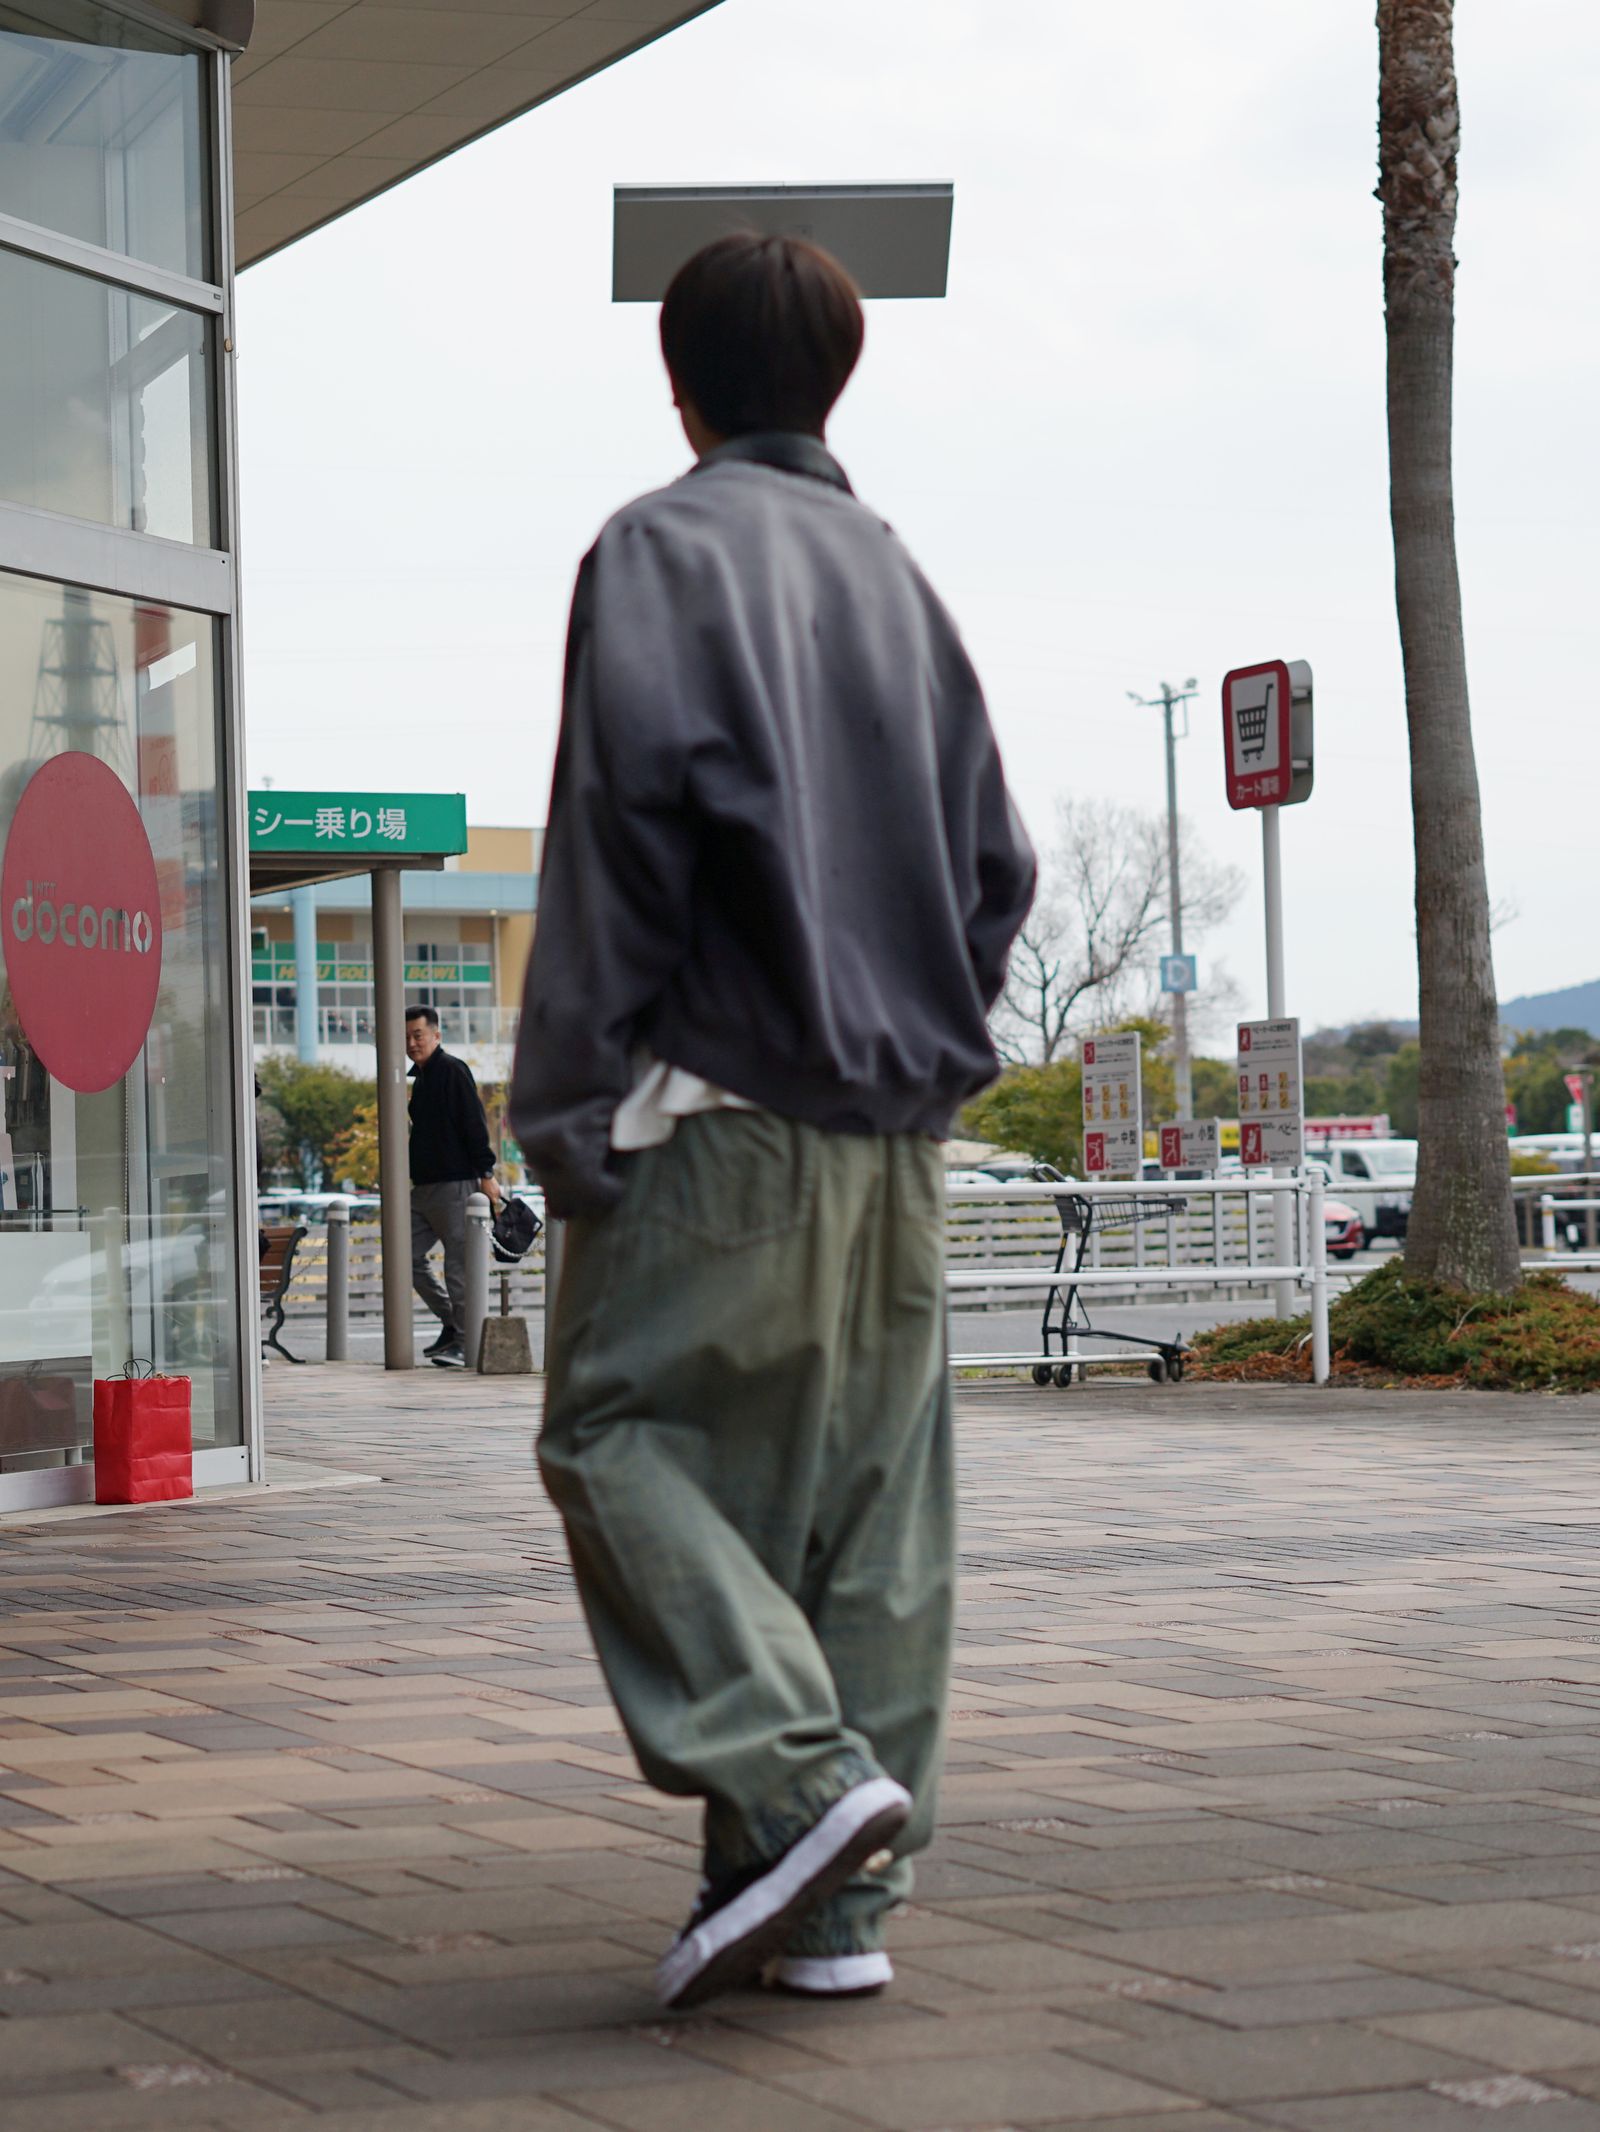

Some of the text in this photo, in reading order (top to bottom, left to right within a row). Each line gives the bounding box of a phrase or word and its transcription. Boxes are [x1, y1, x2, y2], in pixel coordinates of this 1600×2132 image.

[248, 807, 407, 840] シー乗り場
[36, 881, 57, 896] NTT
[12, 880, 153, 953] docomo
[407, 966, 458, 980] BOWL
[1167, 959, 1192, 988] D
[1120, 1129, 1137, 1145] 中型
[1198, 1124, 1216, 1141] 小型
